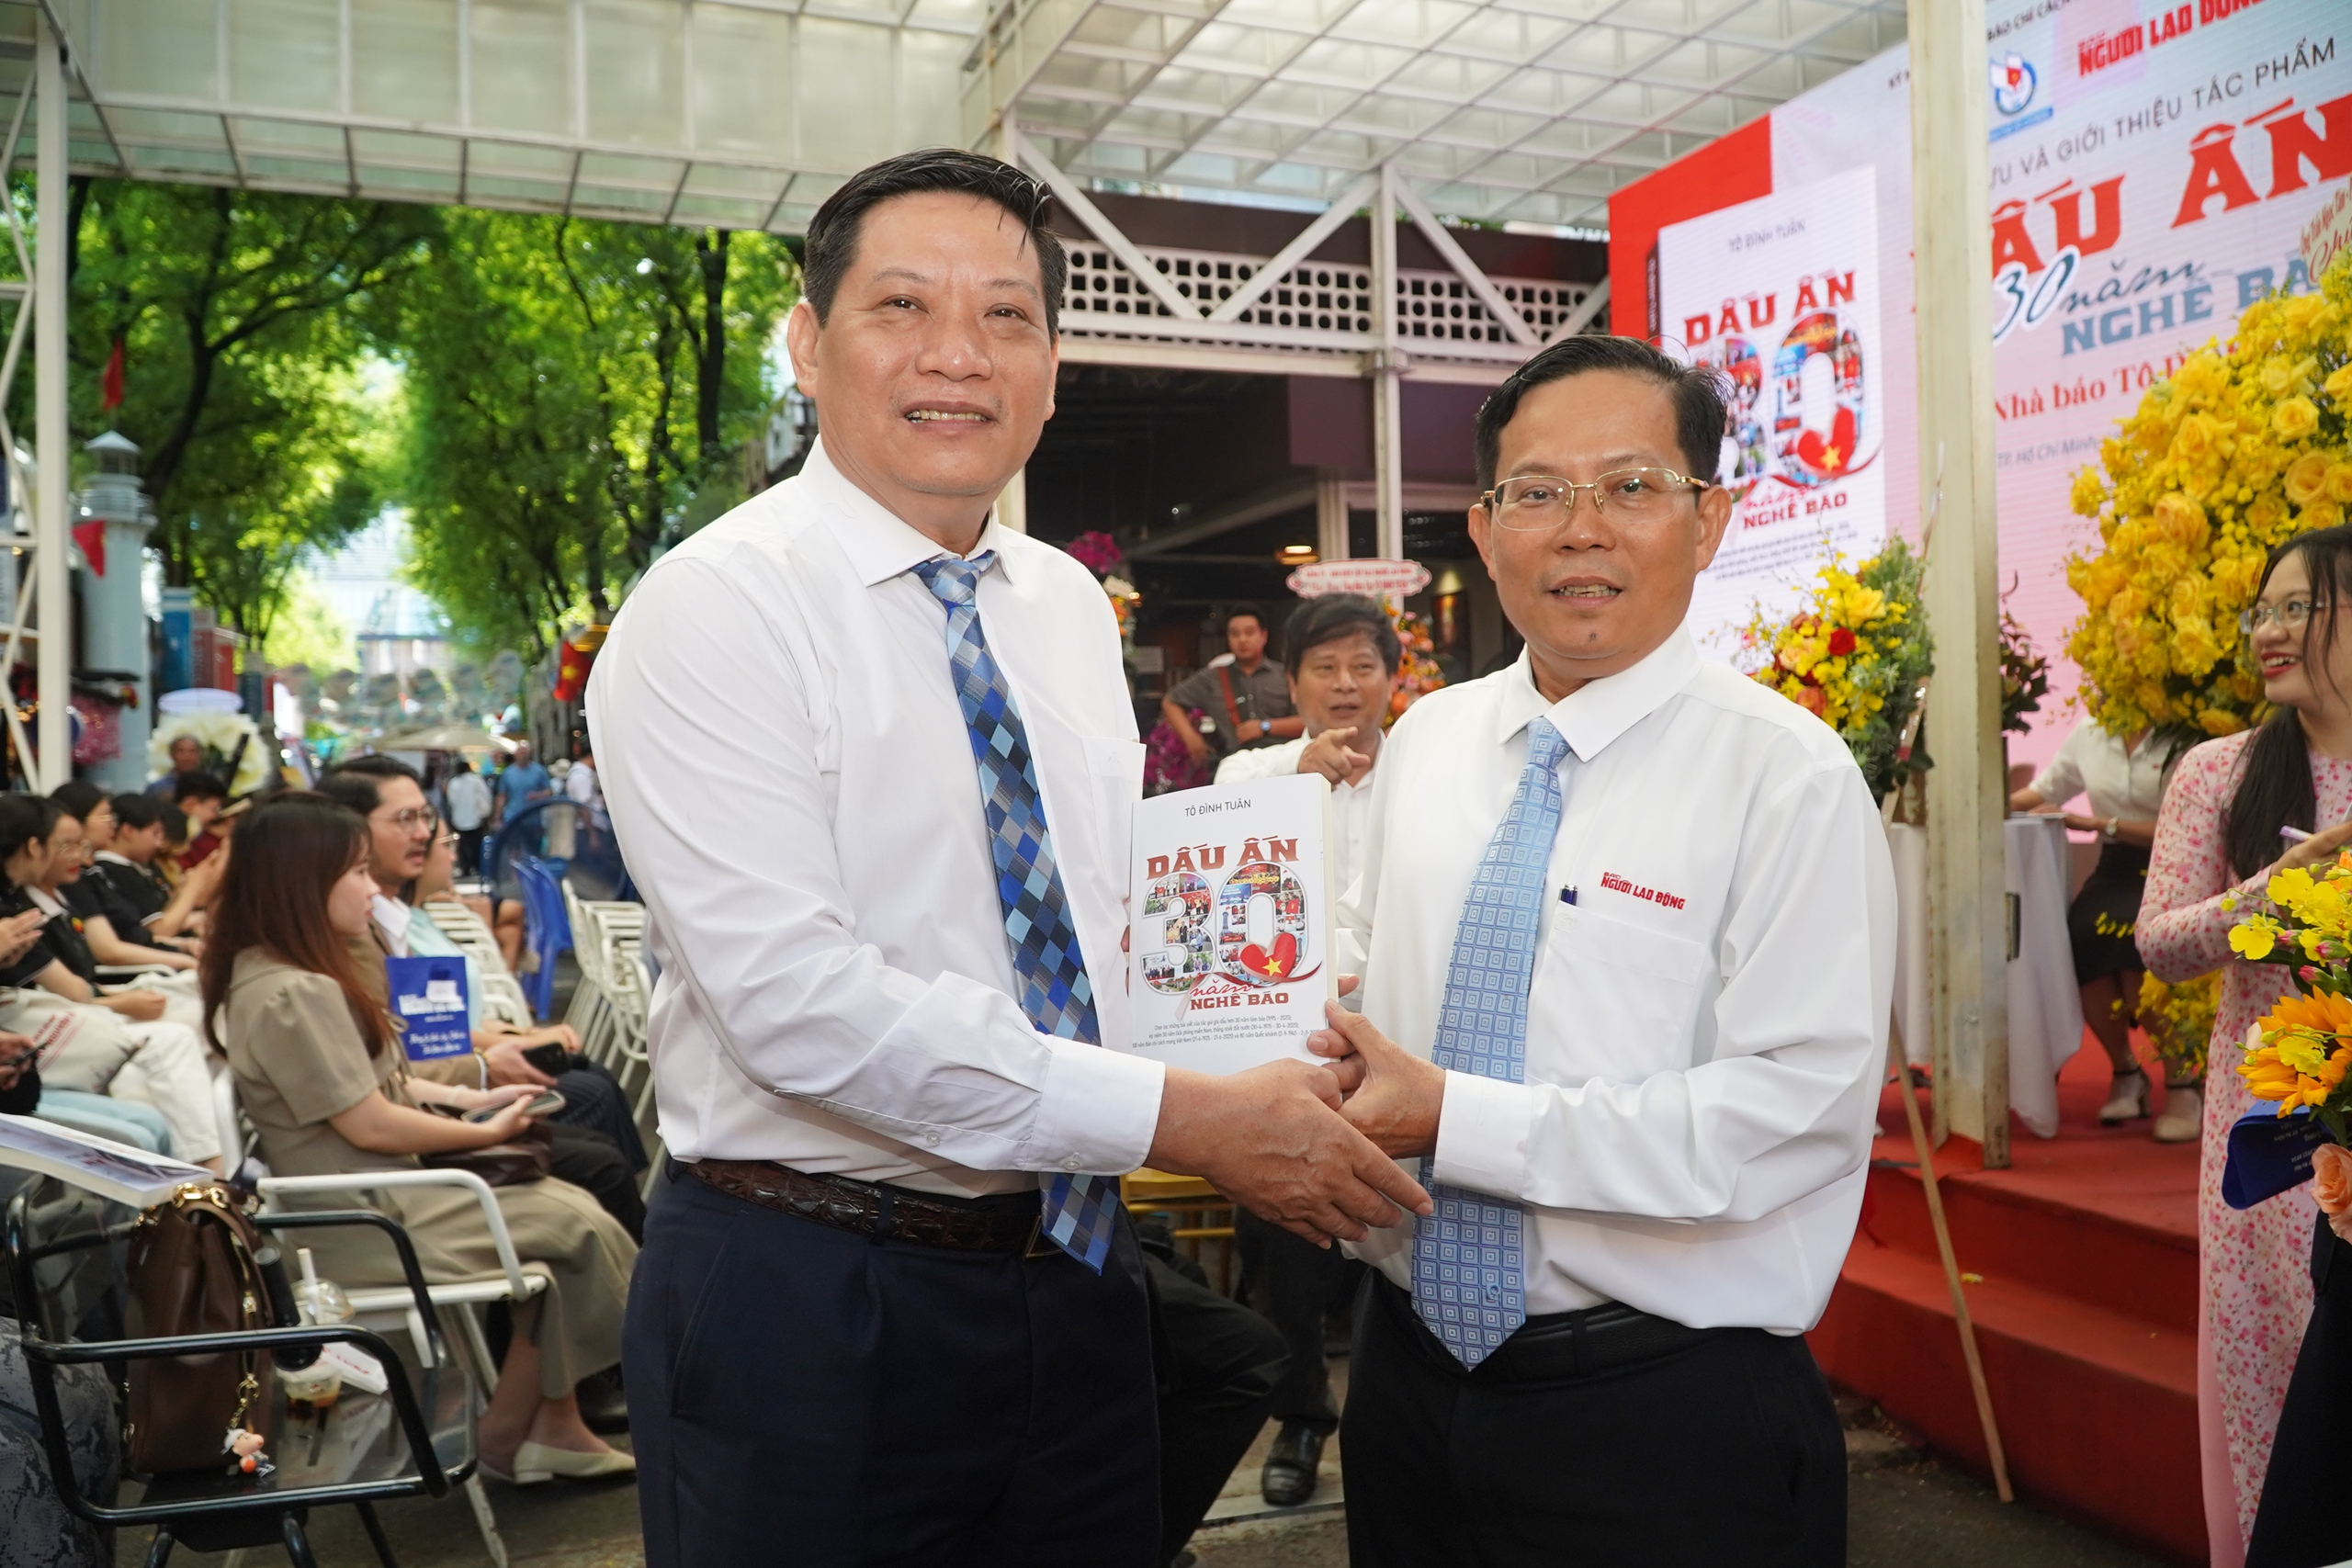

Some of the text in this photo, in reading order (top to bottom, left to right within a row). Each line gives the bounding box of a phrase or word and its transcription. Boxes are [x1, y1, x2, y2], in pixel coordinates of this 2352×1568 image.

[2149, 4, 2193, 47] LAO
[2020, 143, 2049, 175] VÀ
[2057, 121, 2105, 163] GIỚI
[2115, 96, 2182, 139] THIỆU
[2193, 73, 2245, 109] TÁC
[1991, 172, 2127, 279] ẤU
[1992, 244, 2207, 344] 30 năm
[2237, 248, 2317, 310] BÁ
[1683, 290, 1778, 347] DẤU
[1793, 267, 1857, 319] ẤN
[1994, 386, 2045, 422] Nhà
[2052, 375, 2107, 411] báo
[1184, 797, 1251, 818] TÔ ĐÌNH TUÂN
[1146, 835, 1300, 881] DẤU ẤN
[1600, 875, 1687, 910] NGƯỜI LAO ĐỘNG
[1141, 860, 1309, 995] 30
[1189, 978, 1253, 998] năm
[1190, 990, 1289, 1010] NGHỀ BÁO
